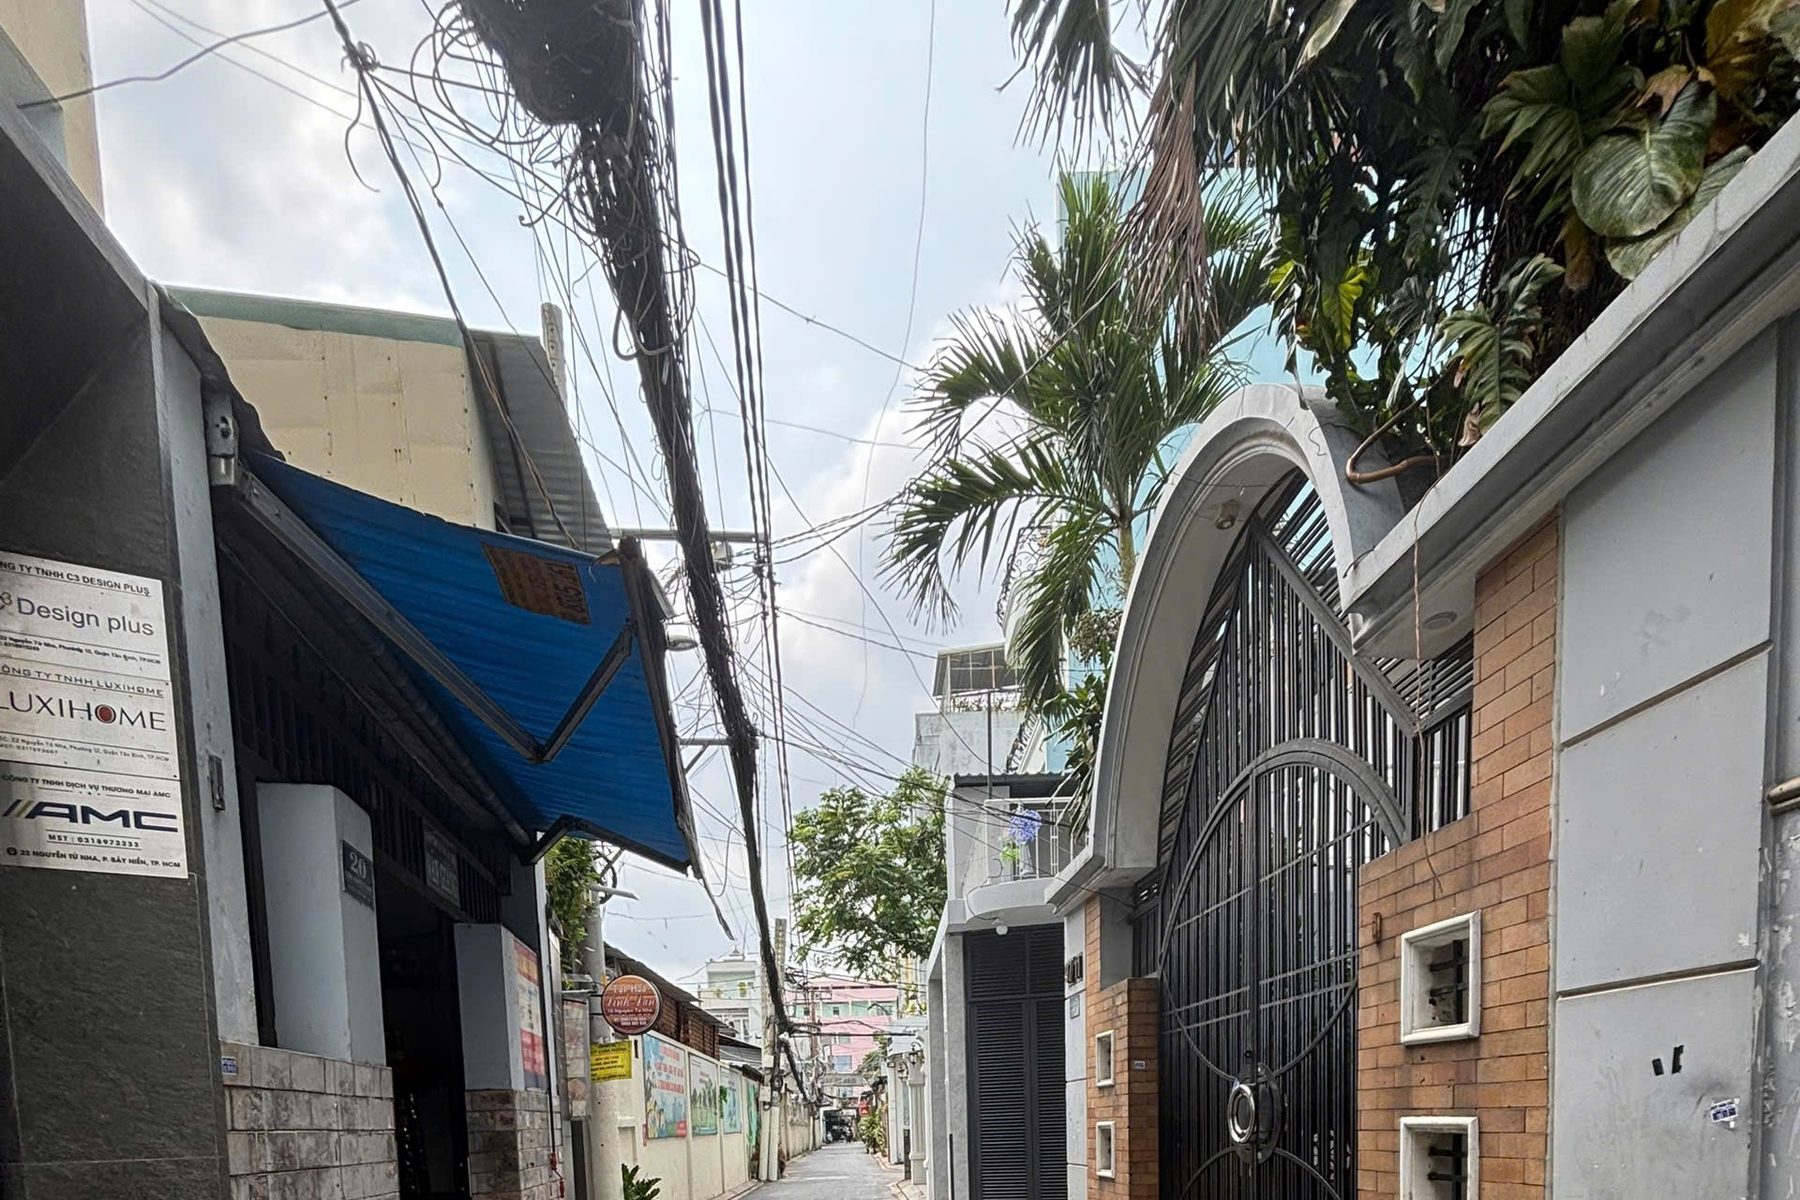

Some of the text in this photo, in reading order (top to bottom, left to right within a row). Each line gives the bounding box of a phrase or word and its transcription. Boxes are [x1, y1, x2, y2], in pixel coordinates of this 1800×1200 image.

[19, 564, 32, 574] TY
[34, 567, 64, 579] TNHH
[66, 571, 80, 582] C3
[82, 575, 121, 590] DESIGN
[123, 584, 150, 595] PLUS
[17, 597, 99, 629] Design
[108, 615, 154, 636] plus
[35, 670, 51, 679] TY
[55, 673, 93, 686] TNHH
[97, 680, 165, 697] LUXIHOME
[1, 774, 28, 783] CÔNG
[41, 778, 64, 787] TNHH
[65, 781, 87, 790] DỊCH
[101, 785, 134, 794] THƯƠNG
[152, 790, 171, 798] AMC
[48, 834, 68, 842] MST
[350, 851, 366, 880] 20
